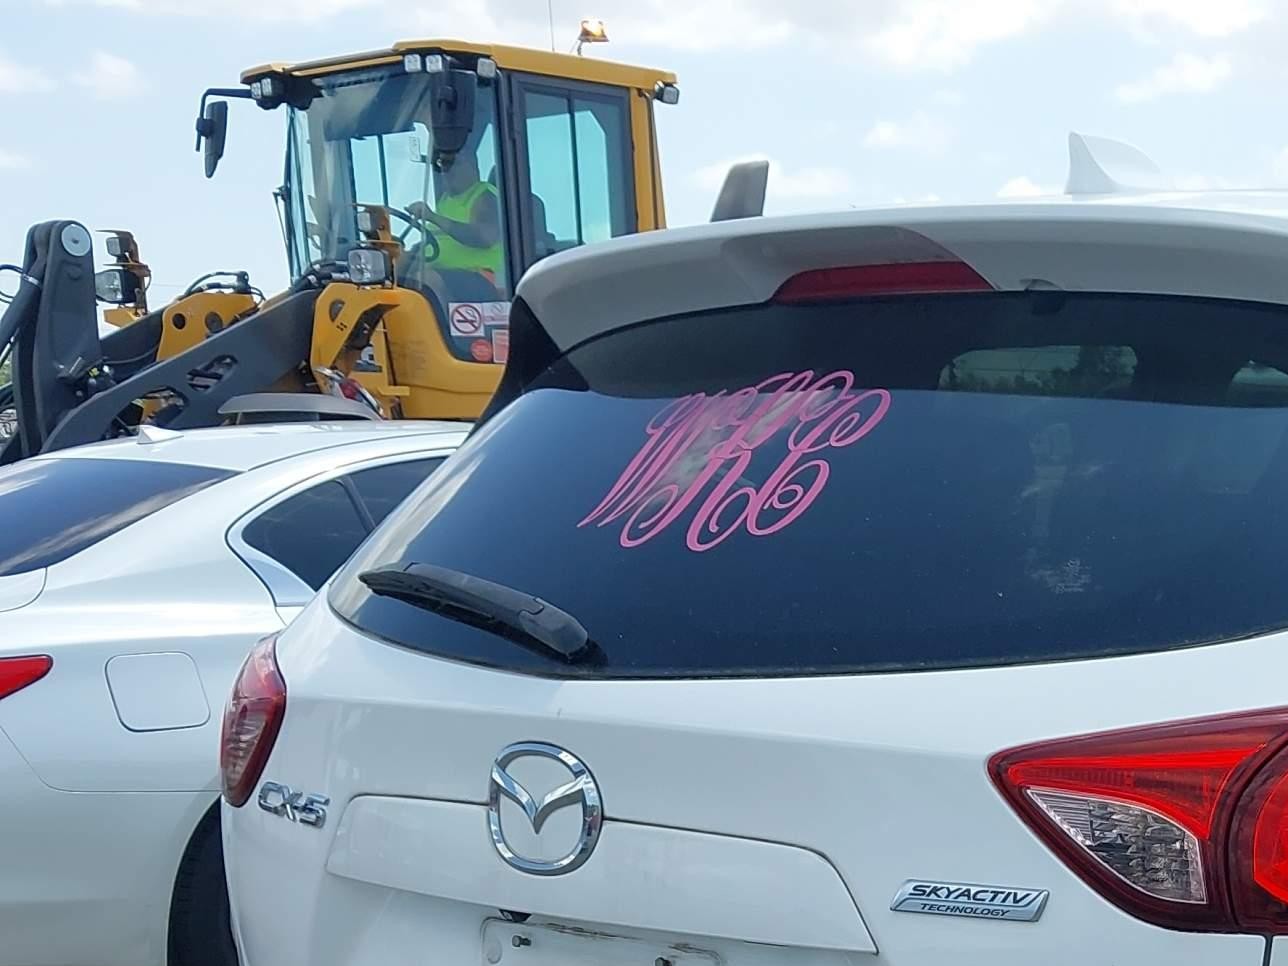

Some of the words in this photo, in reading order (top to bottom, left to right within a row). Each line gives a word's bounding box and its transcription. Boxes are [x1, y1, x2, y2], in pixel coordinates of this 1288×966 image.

[258, 781, 331, 829] CX-5
[908, 884, 1033, 905] SKYACTIV
[920, 902, 1010, 917] TECHNOLOGY
